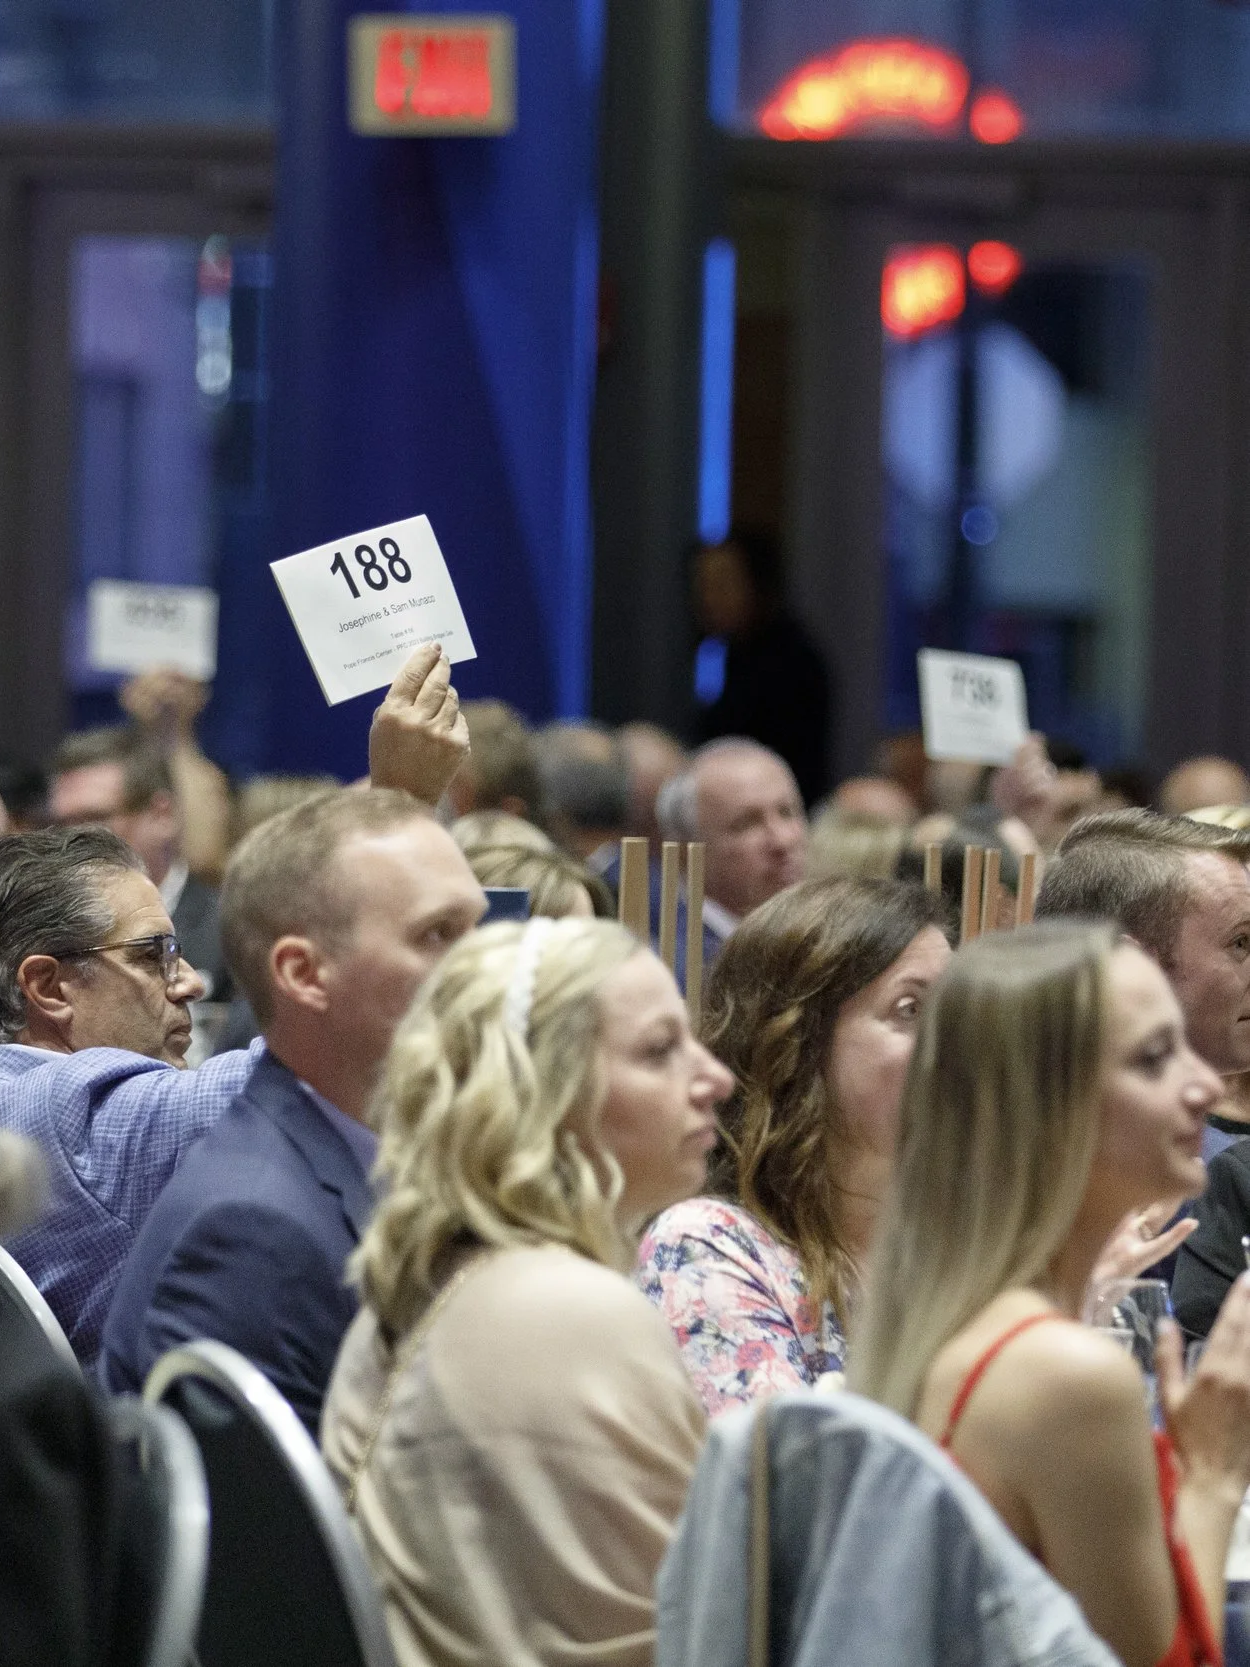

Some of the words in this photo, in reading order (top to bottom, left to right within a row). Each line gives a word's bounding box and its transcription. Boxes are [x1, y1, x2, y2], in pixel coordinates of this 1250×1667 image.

[330, 538, 411, 598] 188
[339, 612, 382, 633] Josephine
[383, 607, 390, 616] &
[390, 602, 408, 614] Sam
[375, 649, 392, 658] Center
